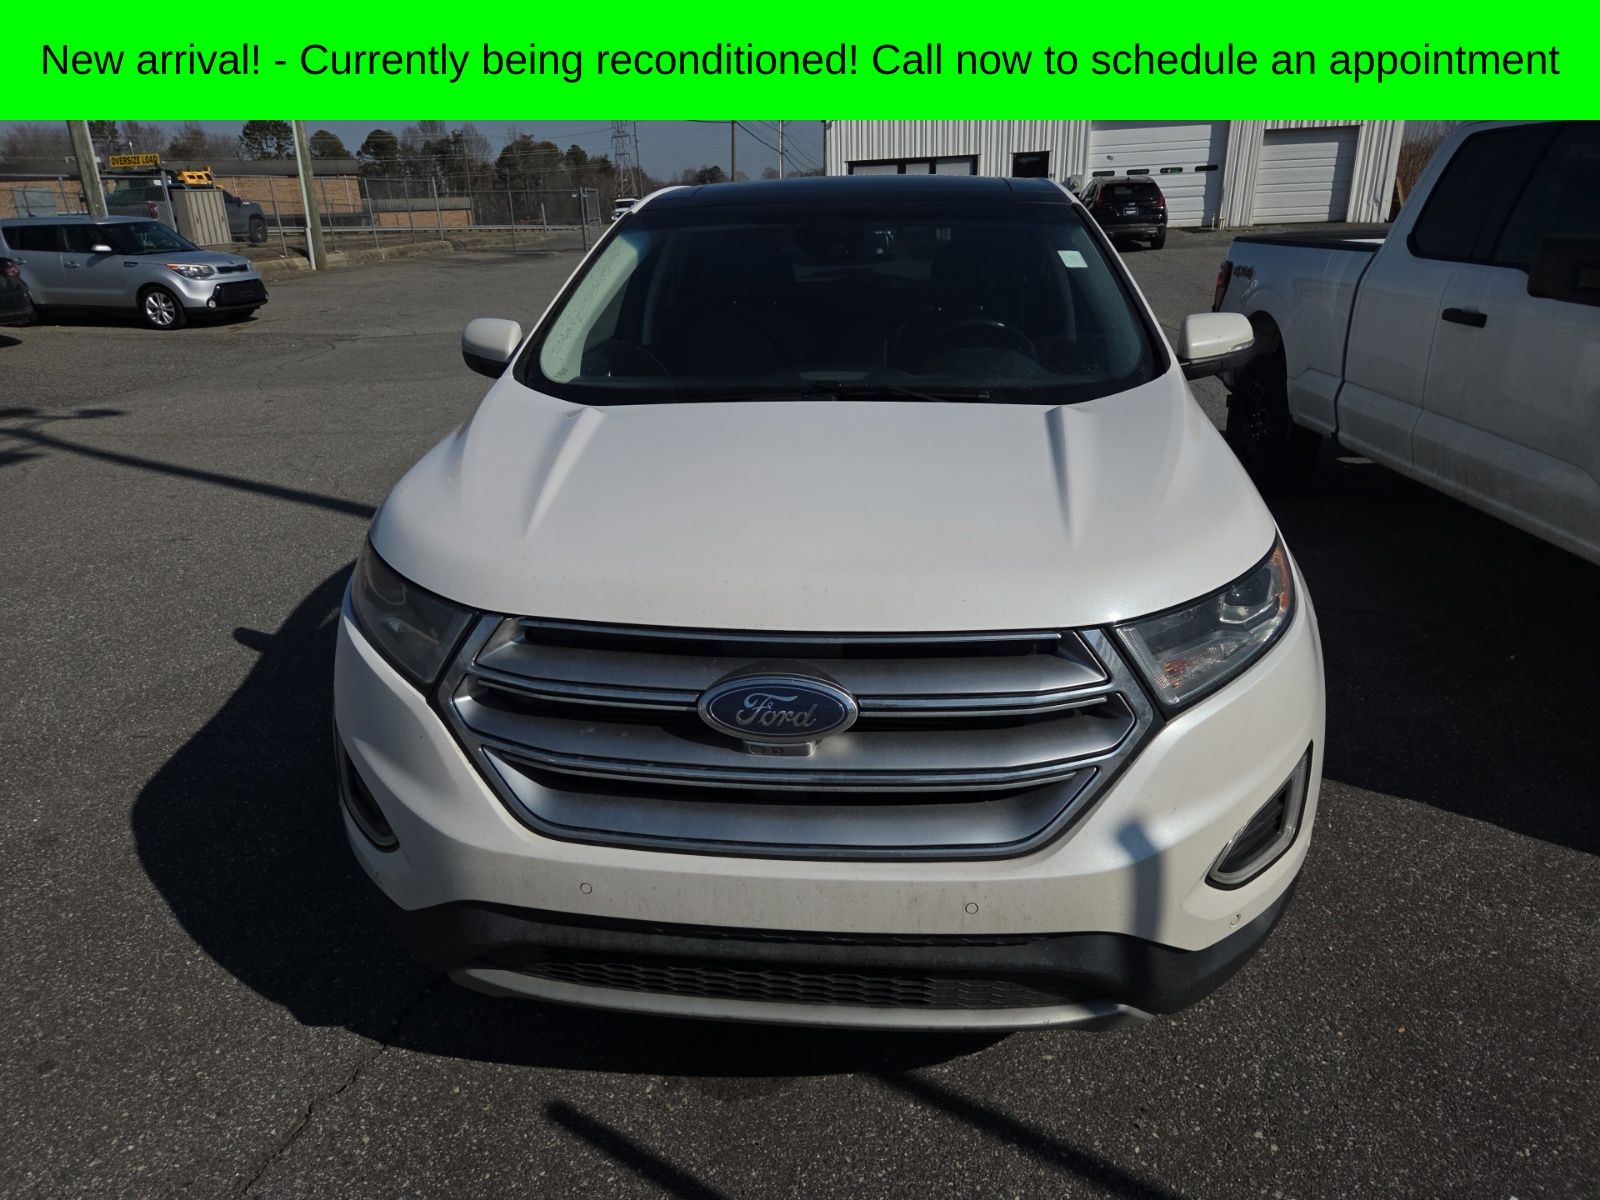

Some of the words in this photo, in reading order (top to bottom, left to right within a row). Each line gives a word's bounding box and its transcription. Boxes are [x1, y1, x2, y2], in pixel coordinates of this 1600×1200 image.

[111, 156, 141, 166] OVERSIZE
[142, 155, 158, 165] LOAD
[735, 692, 818, 728] Ford
